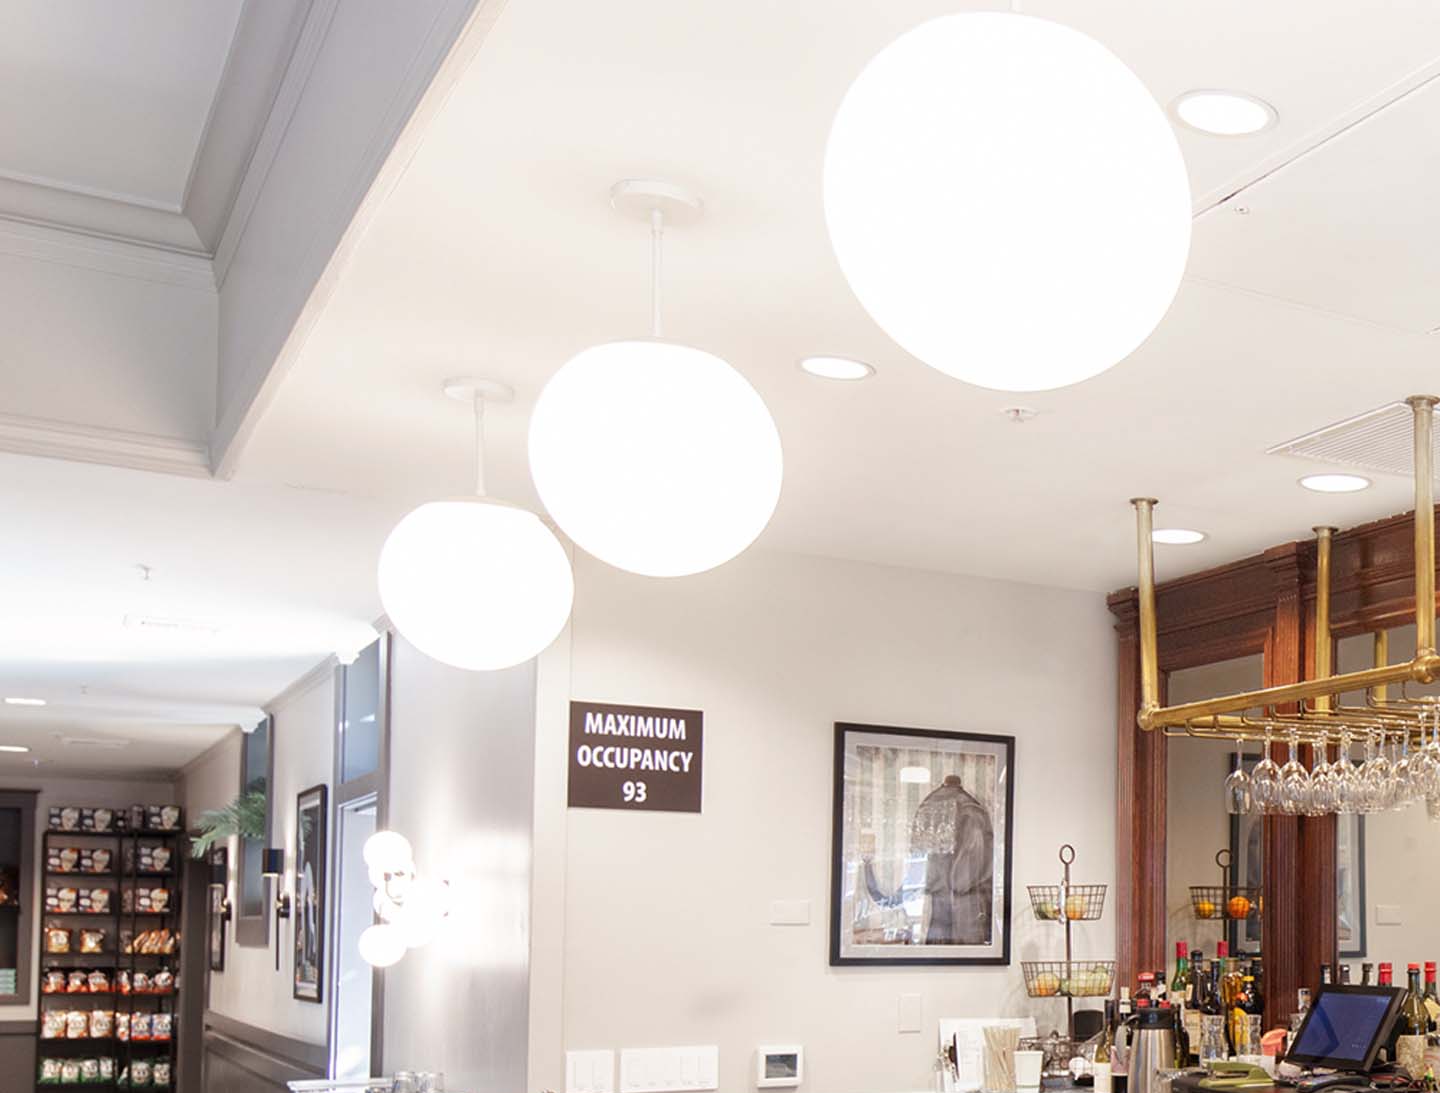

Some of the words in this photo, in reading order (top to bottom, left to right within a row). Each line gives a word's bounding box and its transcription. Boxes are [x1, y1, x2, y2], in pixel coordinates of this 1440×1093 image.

[585, 712, 686, 740] MAXIMUM
[577, 745, 693, 772] OCCUPANCY
[622, 781, 647, 803] 93
